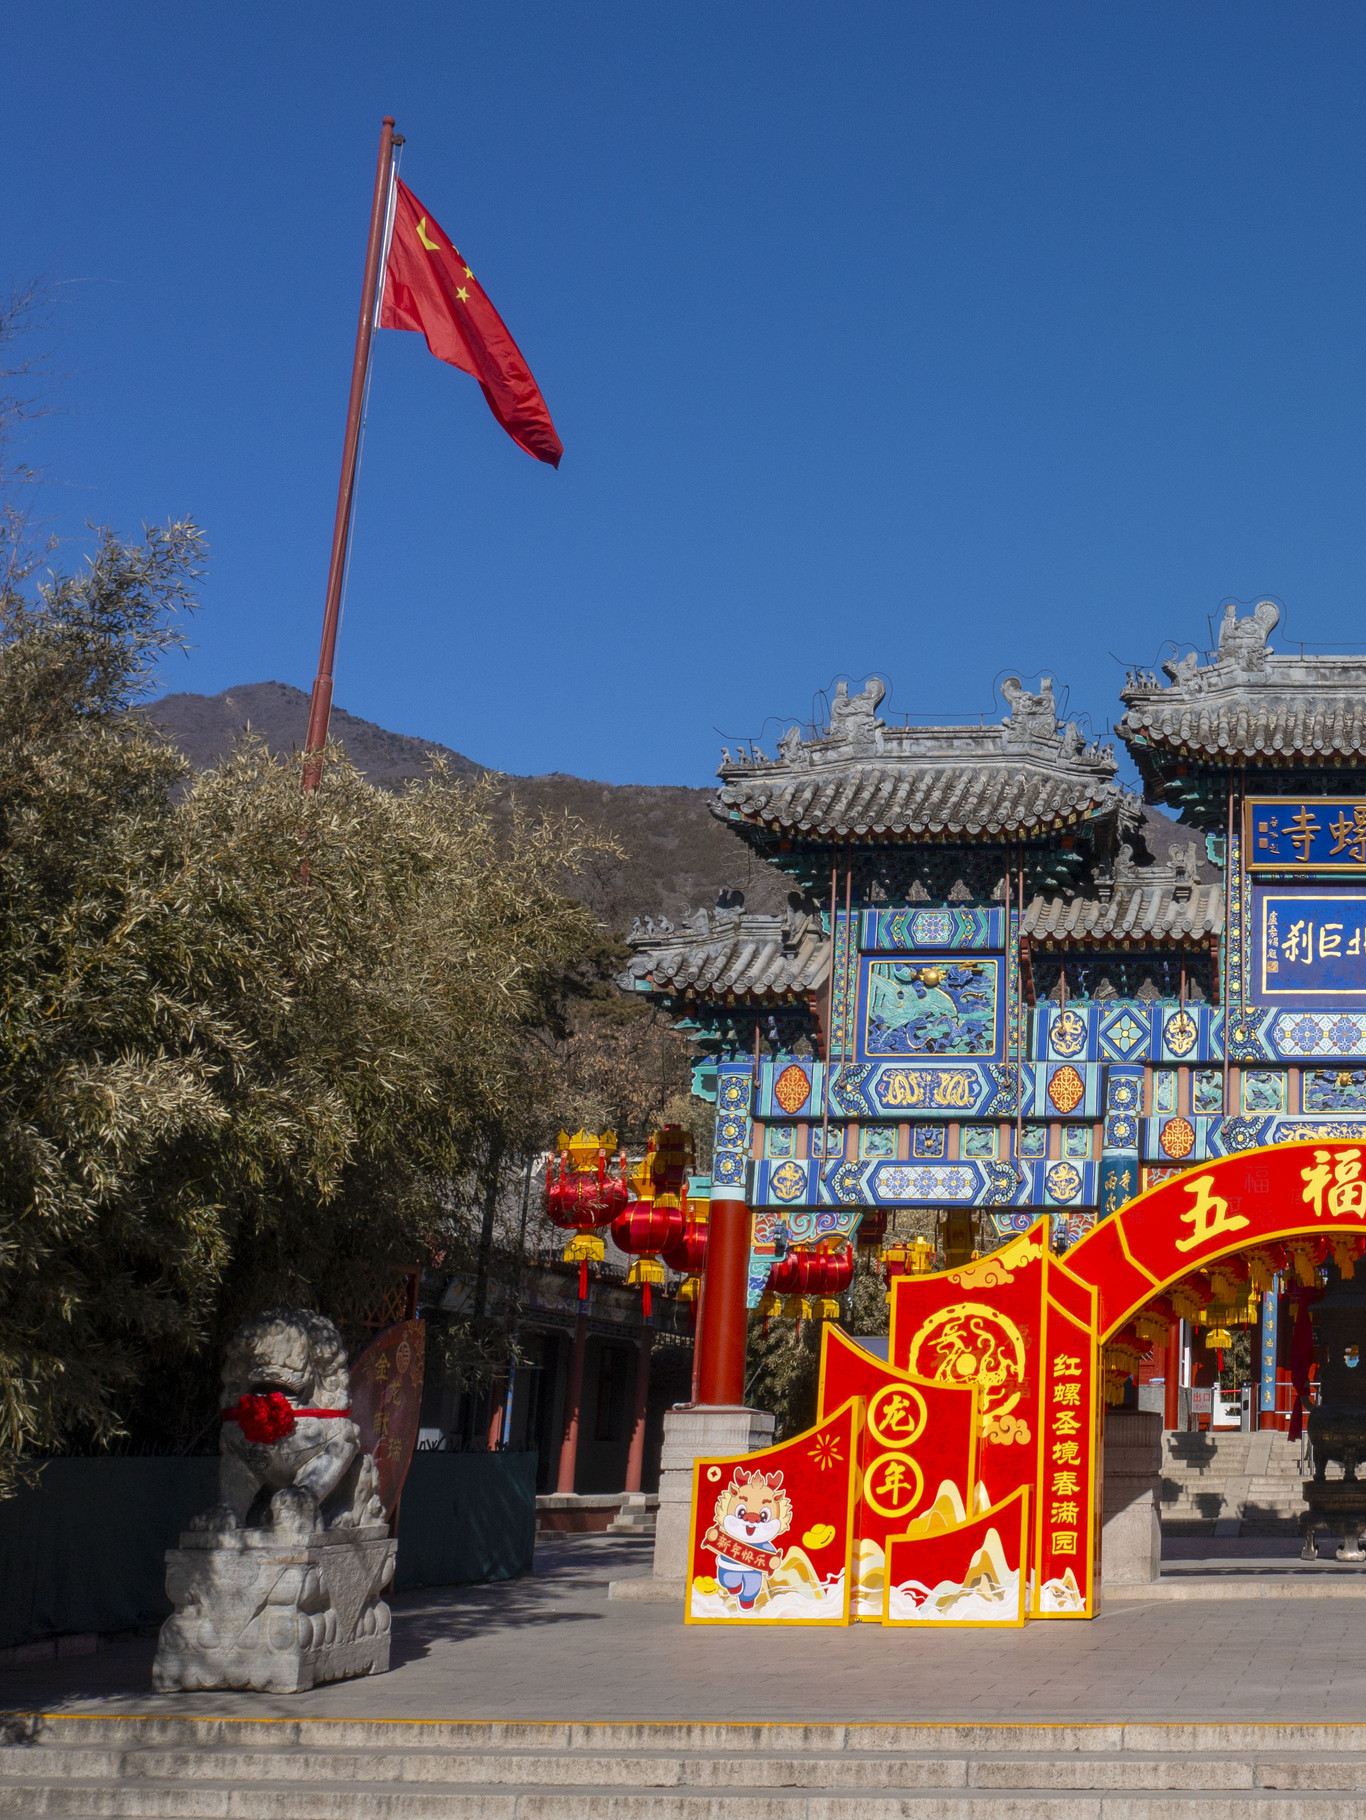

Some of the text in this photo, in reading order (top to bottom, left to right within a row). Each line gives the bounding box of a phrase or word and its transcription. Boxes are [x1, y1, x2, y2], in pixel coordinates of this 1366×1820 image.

[1050, 1353, 1082, 1556] 红螺圣境春满园
[716, 1534, 766, 1567] 新年快乐
